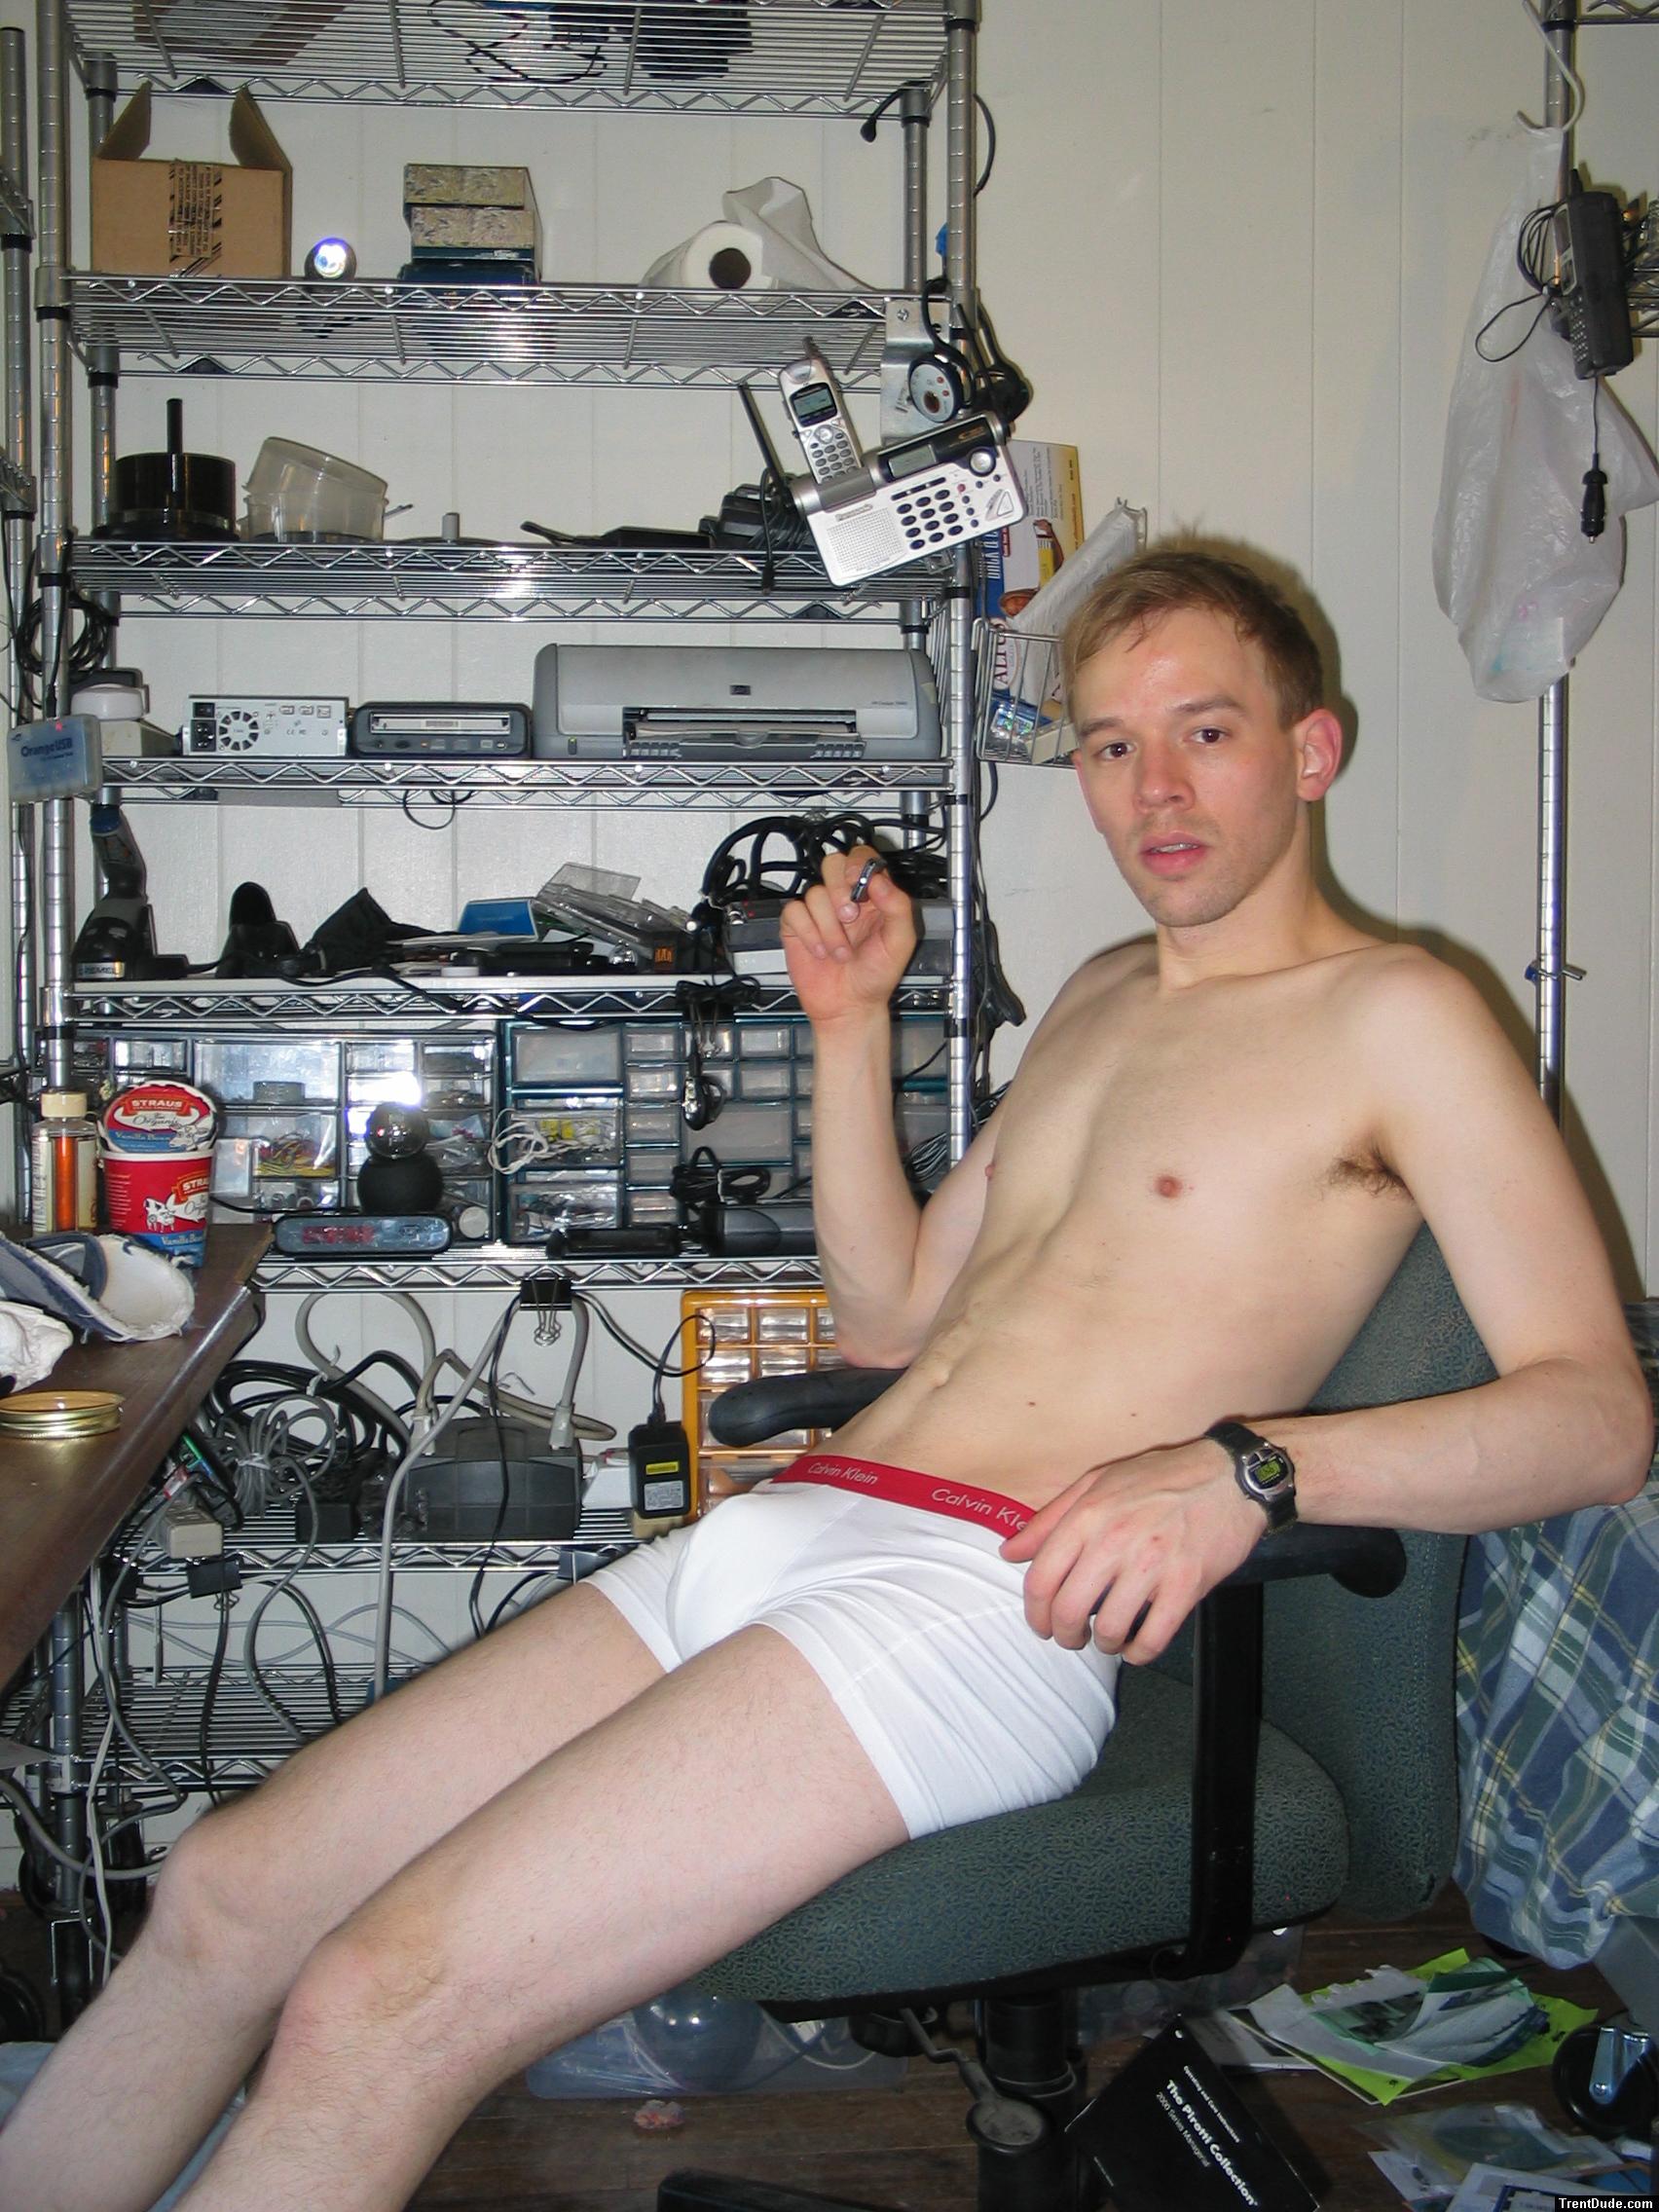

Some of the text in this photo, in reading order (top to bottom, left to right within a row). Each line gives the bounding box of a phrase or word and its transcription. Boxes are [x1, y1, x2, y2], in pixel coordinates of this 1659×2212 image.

[131, 1099, 183, 1108] STRAUS
[807, 1461, 878, 1486] Calvin Klein
[931, 1488, 1029, 1531] Calvin Kle
[1166, 2079, 1183, 2106] The
